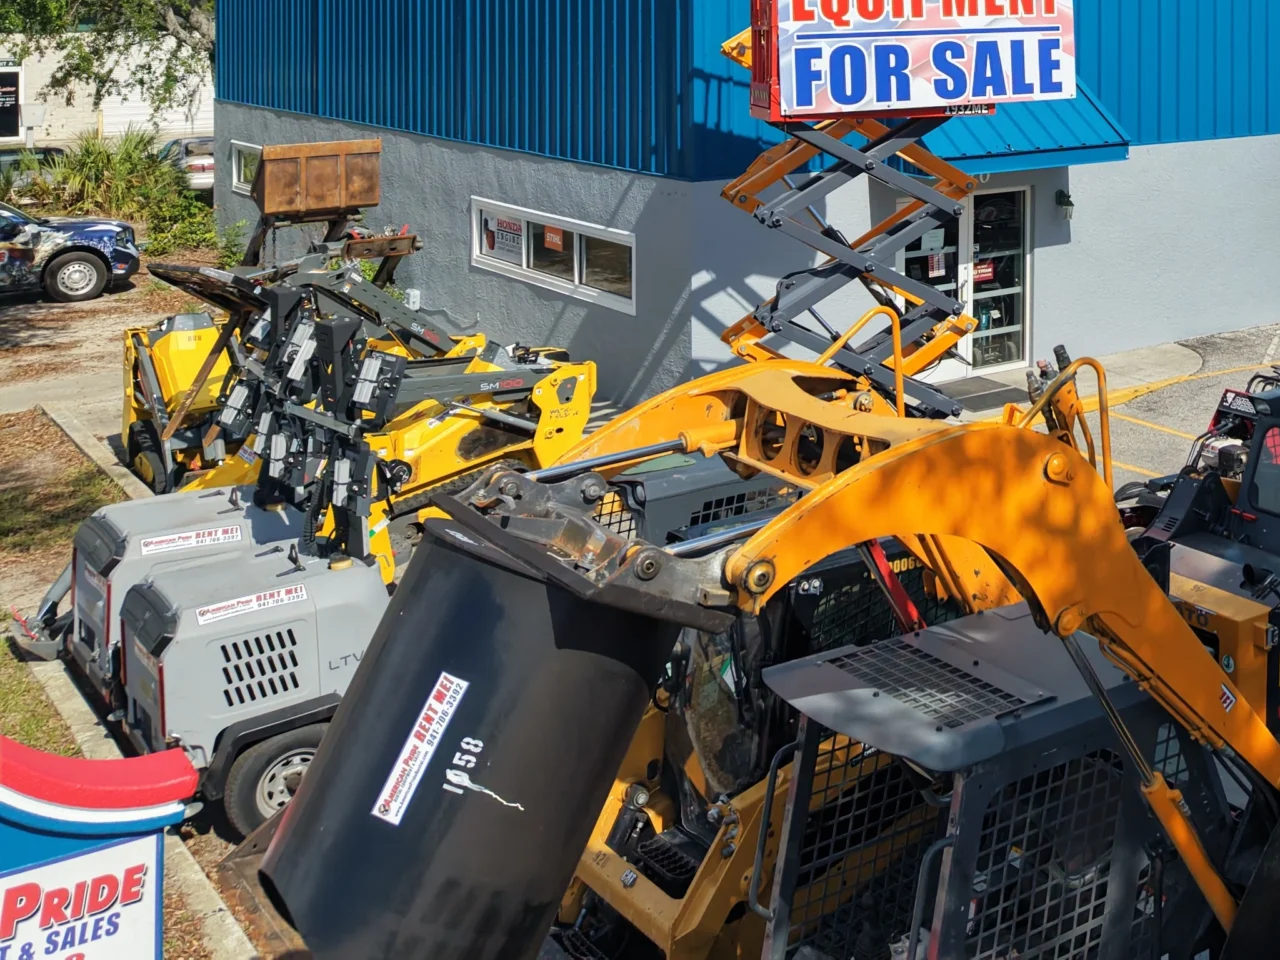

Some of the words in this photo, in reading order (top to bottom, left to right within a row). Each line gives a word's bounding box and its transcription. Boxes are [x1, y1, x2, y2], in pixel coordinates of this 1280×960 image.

[794, 44, 910, 107] FOR
[934, 38, 1062, 100] SALE
[546, 233, 561, 244] STIHL
[480, 378, 523, 391] SM100
[195, 529, 218, 539] RENT
[221, 527, 238, 536] ME!
[255, 590, 281, 602] RENT
[285, 586, 304, 596] ME!
[413, 703, 439, 744] RENT
[433, 675, 455, 705] ME!
[427, 683, 464, 747] 941-706-3392
[383, 767, 407, 807] AMERICAN
[403, 744, 419, 767] PRIDE
[621, 869, 637, 886] CAT
[0, 863, 148, 942] PRIDE
[44, 912, 121, 955] SALES
